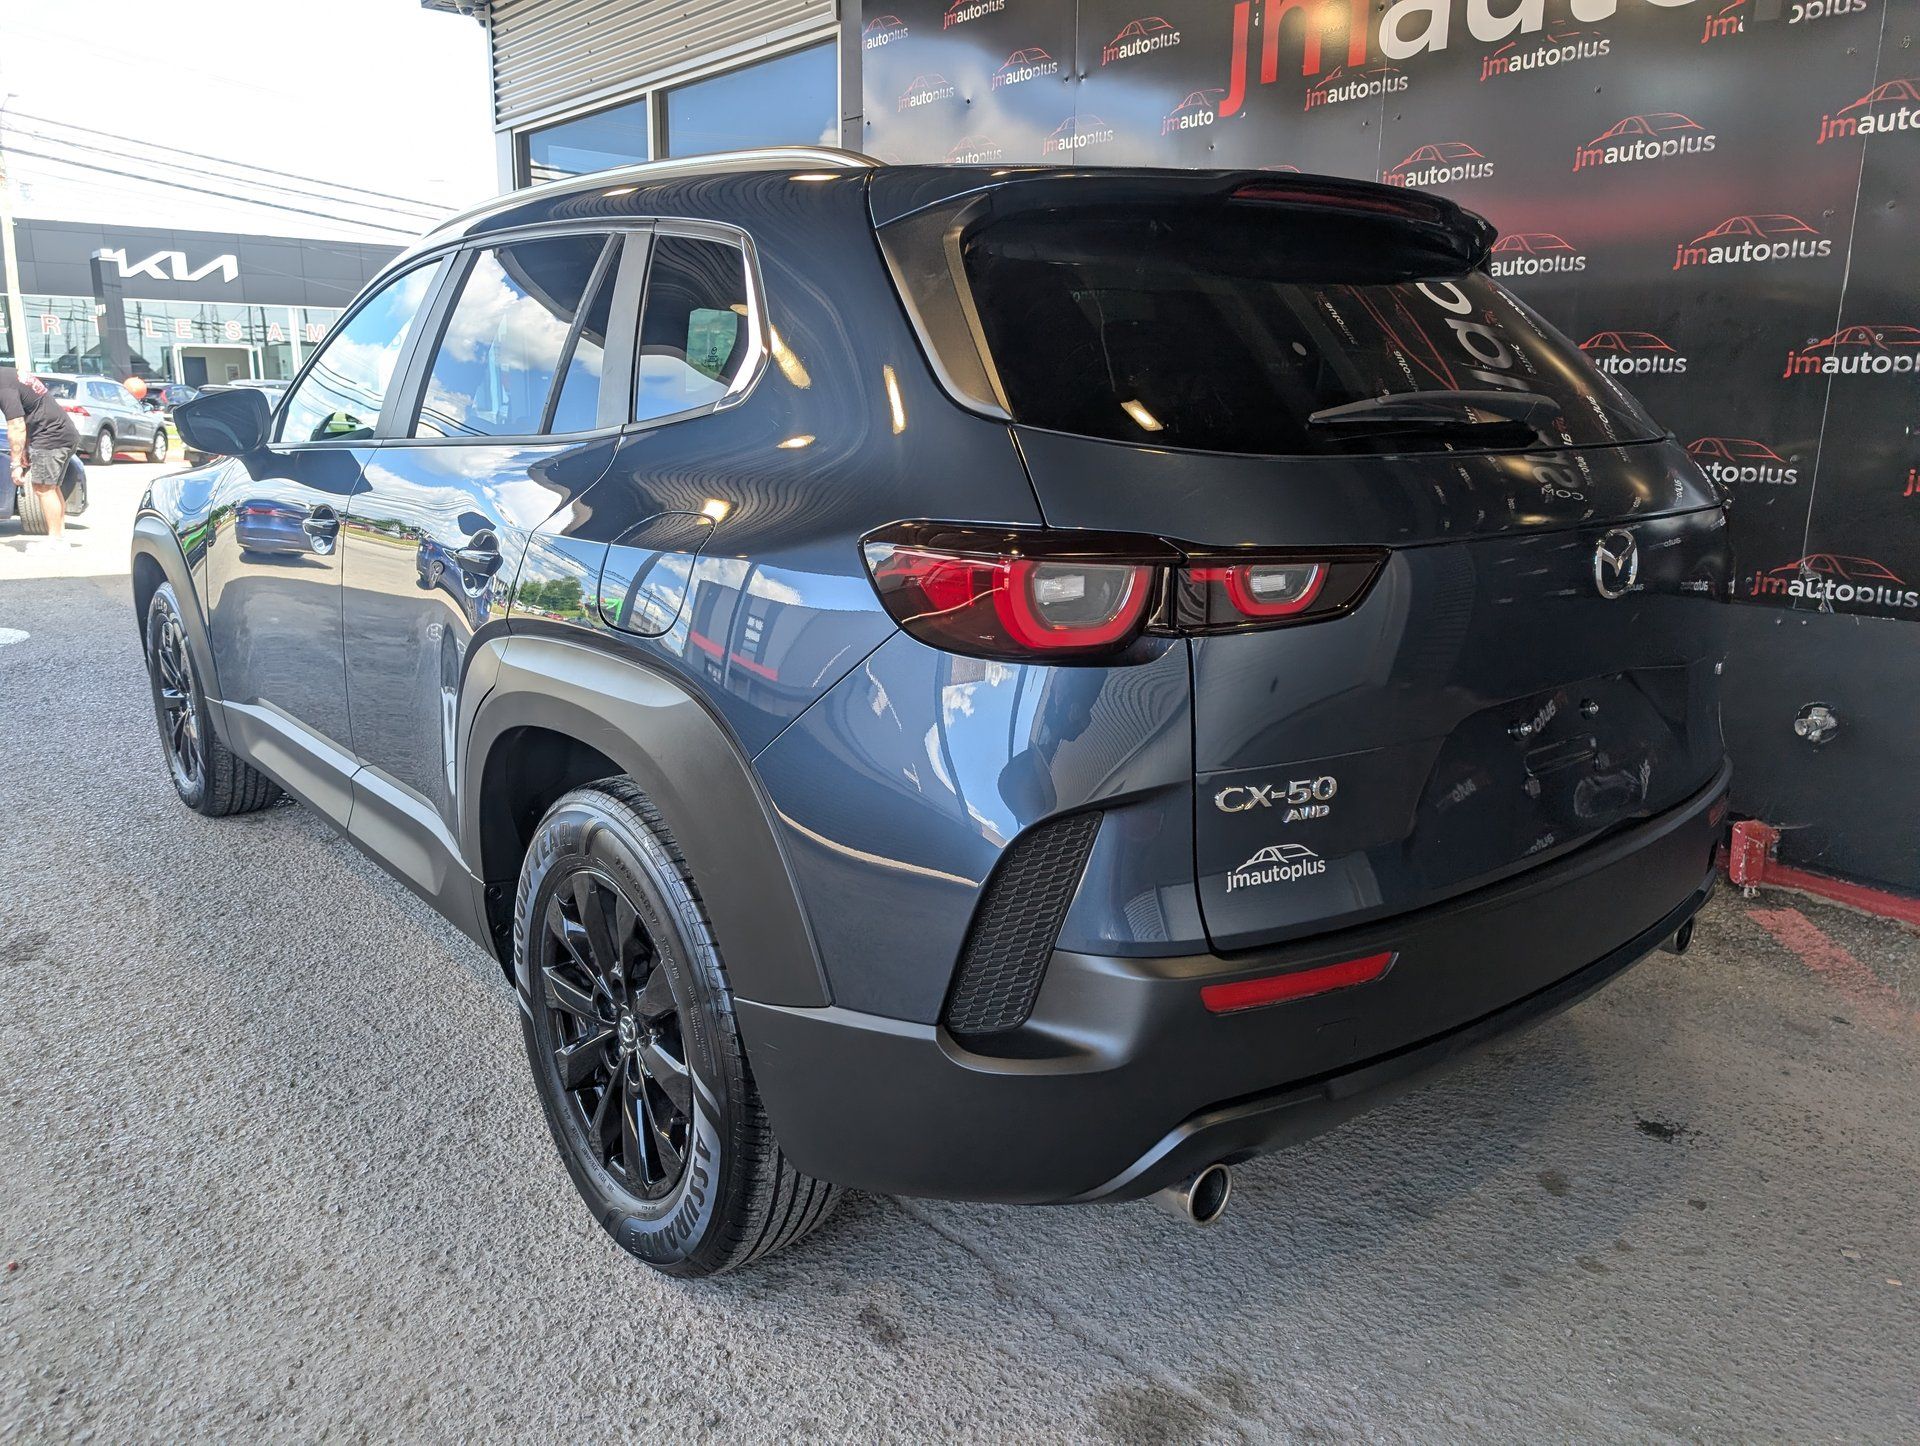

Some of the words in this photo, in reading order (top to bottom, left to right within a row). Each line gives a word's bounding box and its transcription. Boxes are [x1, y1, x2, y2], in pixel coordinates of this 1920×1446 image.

[943, 0, 1005, 29] jmautoplus
[1102, 31, 1180, 66] jmautoplus
[1480, 39, 1610, 81] jmautoplus
[991, 61, 1058, 91] jmautoplus
[898, 87, 954, 112] jmautoplus
[1304, 74, 1408, 112] jmautoplus
[1161, 111, 1214, 136] jmauto
[1042, 129, 1113, 156] jmautoplus
[1573, 134, 1715, 172] jmautoplus
[1382, 161, 1494, 188] jmautoplus
[113, 248, 238, 283] KIA
[1673, 238, 1831, 270] jmautoplus
[1702, 462, 1797, 485] toplus
[1904, 469, 1920, 497] j
[1751, 571, 1920, 608] jmautoplus
[1214, 776, 1338, 813] CX-50
[1282, 804, 1330, 823] AWD
[1226, 859, 1326, 893] jmautoplus
[628, 1127, 711, 1257] ASSURANCE
